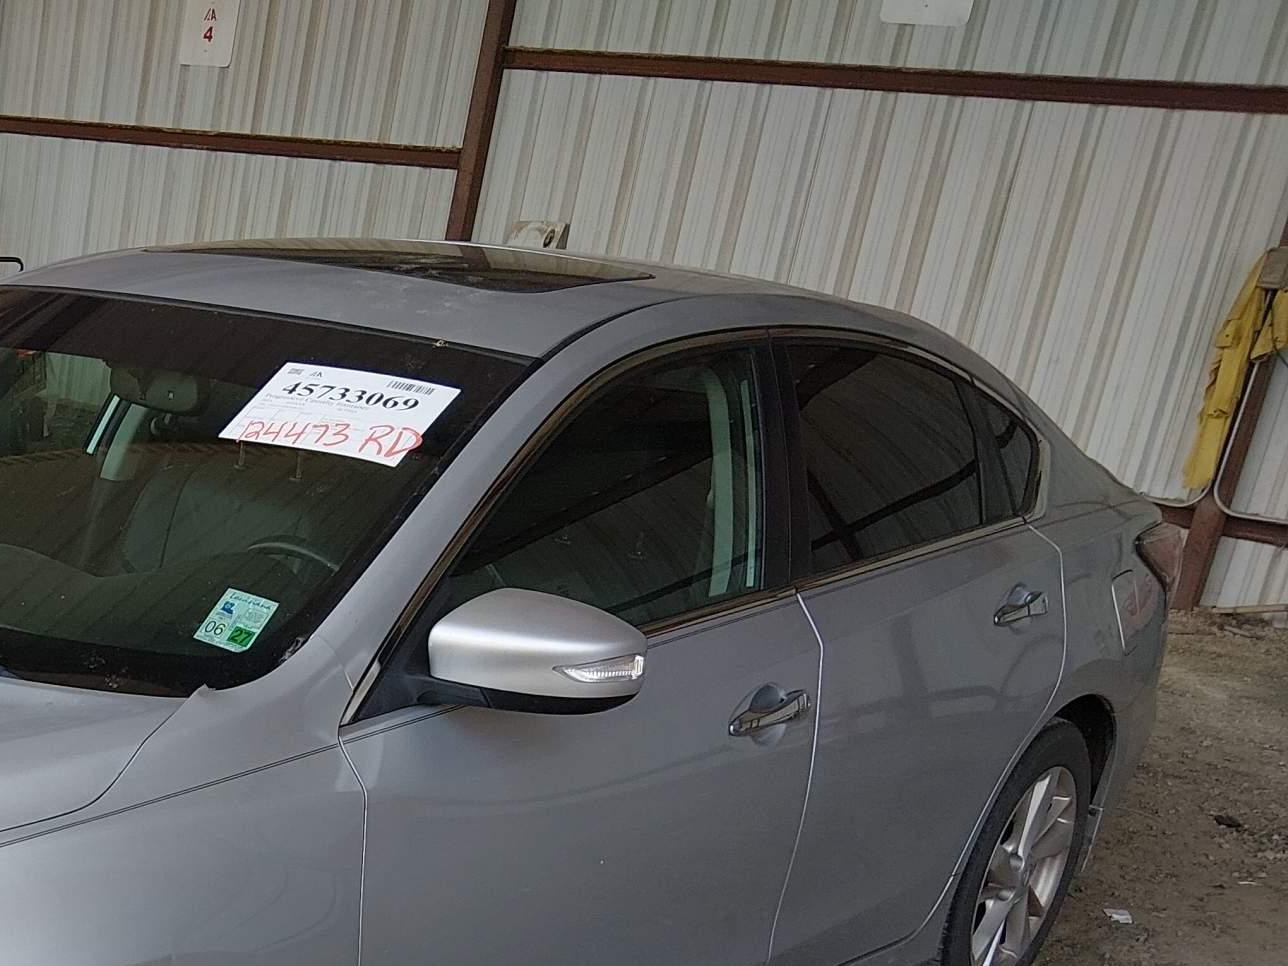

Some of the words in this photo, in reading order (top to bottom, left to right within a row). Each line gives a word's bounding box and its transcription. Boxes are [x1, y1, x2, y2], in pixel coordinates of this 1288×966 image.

[203, 26, 214, 42] 4
[282, 381, 420, 411] 45733069
[358, 424, 424, 457] RD
[204, 620, 226, 636] 06
[231, 629, 252, 644] 27
